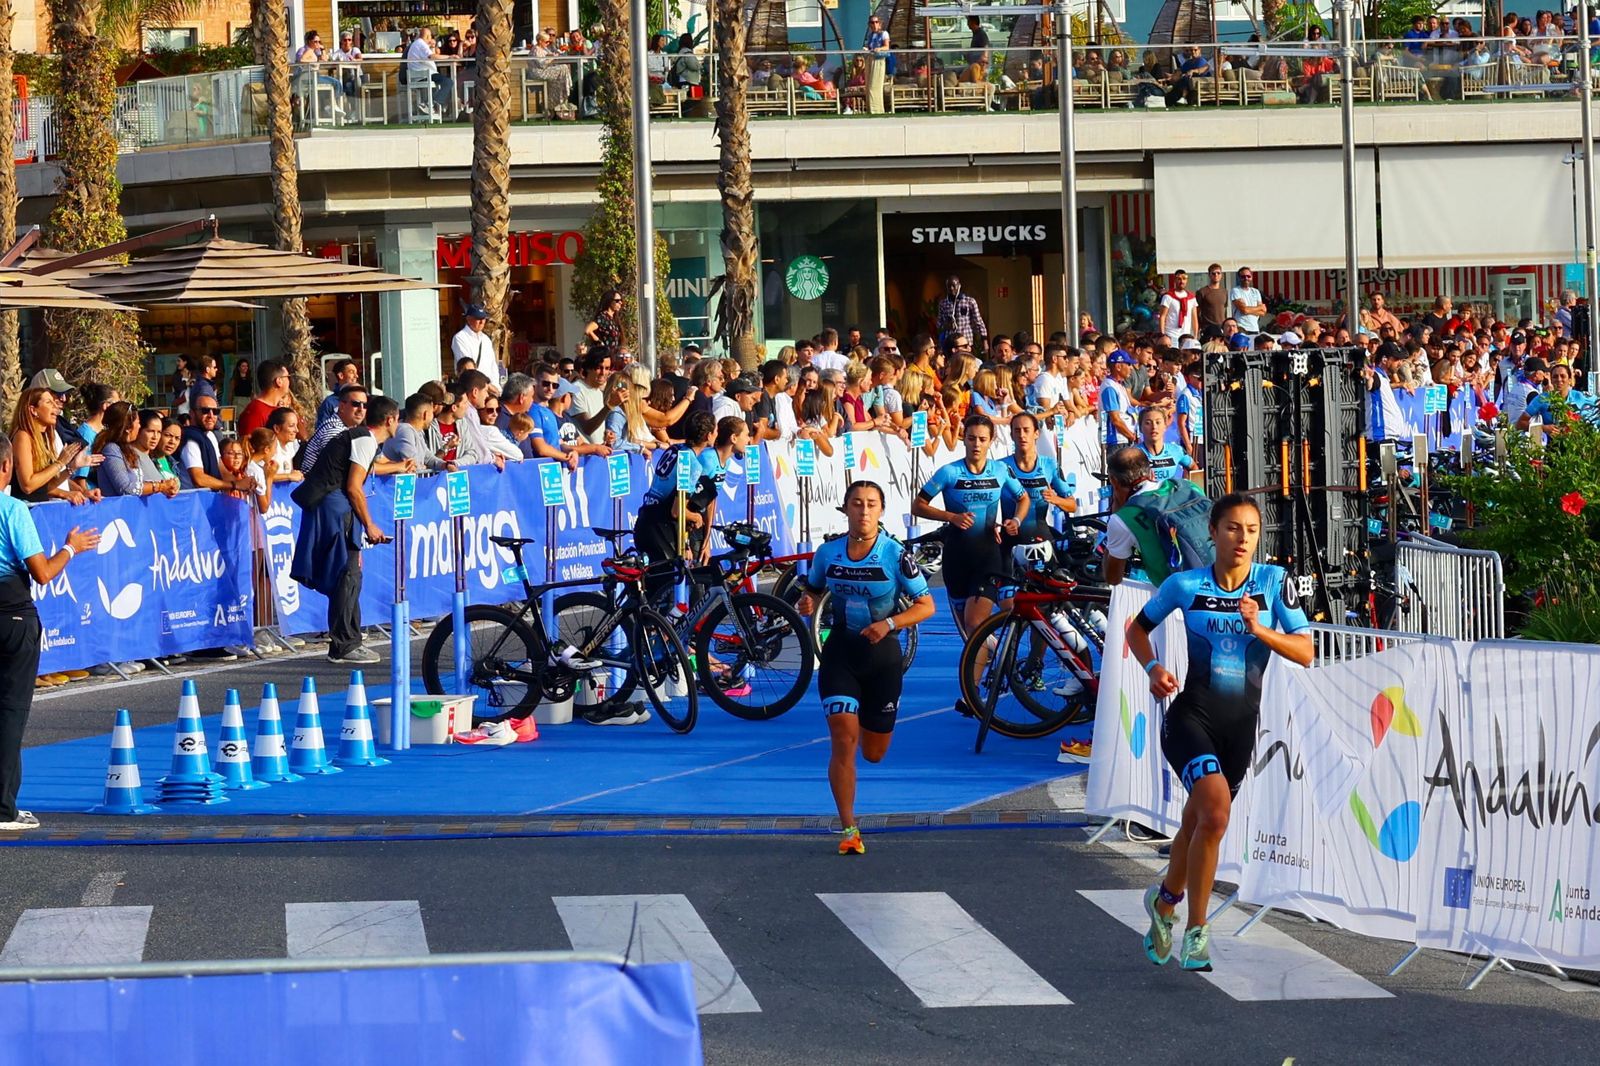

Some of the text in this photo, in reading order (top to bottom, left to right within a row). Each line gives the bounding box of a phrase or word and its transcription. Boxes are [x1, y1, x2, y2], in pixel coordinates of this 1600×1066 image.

[911, 225, 1047, 243] STARBUCKS
[437, 231, 583, 268] MISO
[544, 538, 607, 562] utación Provincial
[562, 563, 594, 580] de Málaga
[1254, 829, 1287, 847] Junta
[1252, 847, 1310, 871] de Andalucía
[1474, 874, 1526, 893] UNIÓN EUROPEA
[1566, 883, 1590, 900] Junta
[1565, 903, 1573, 918] de
